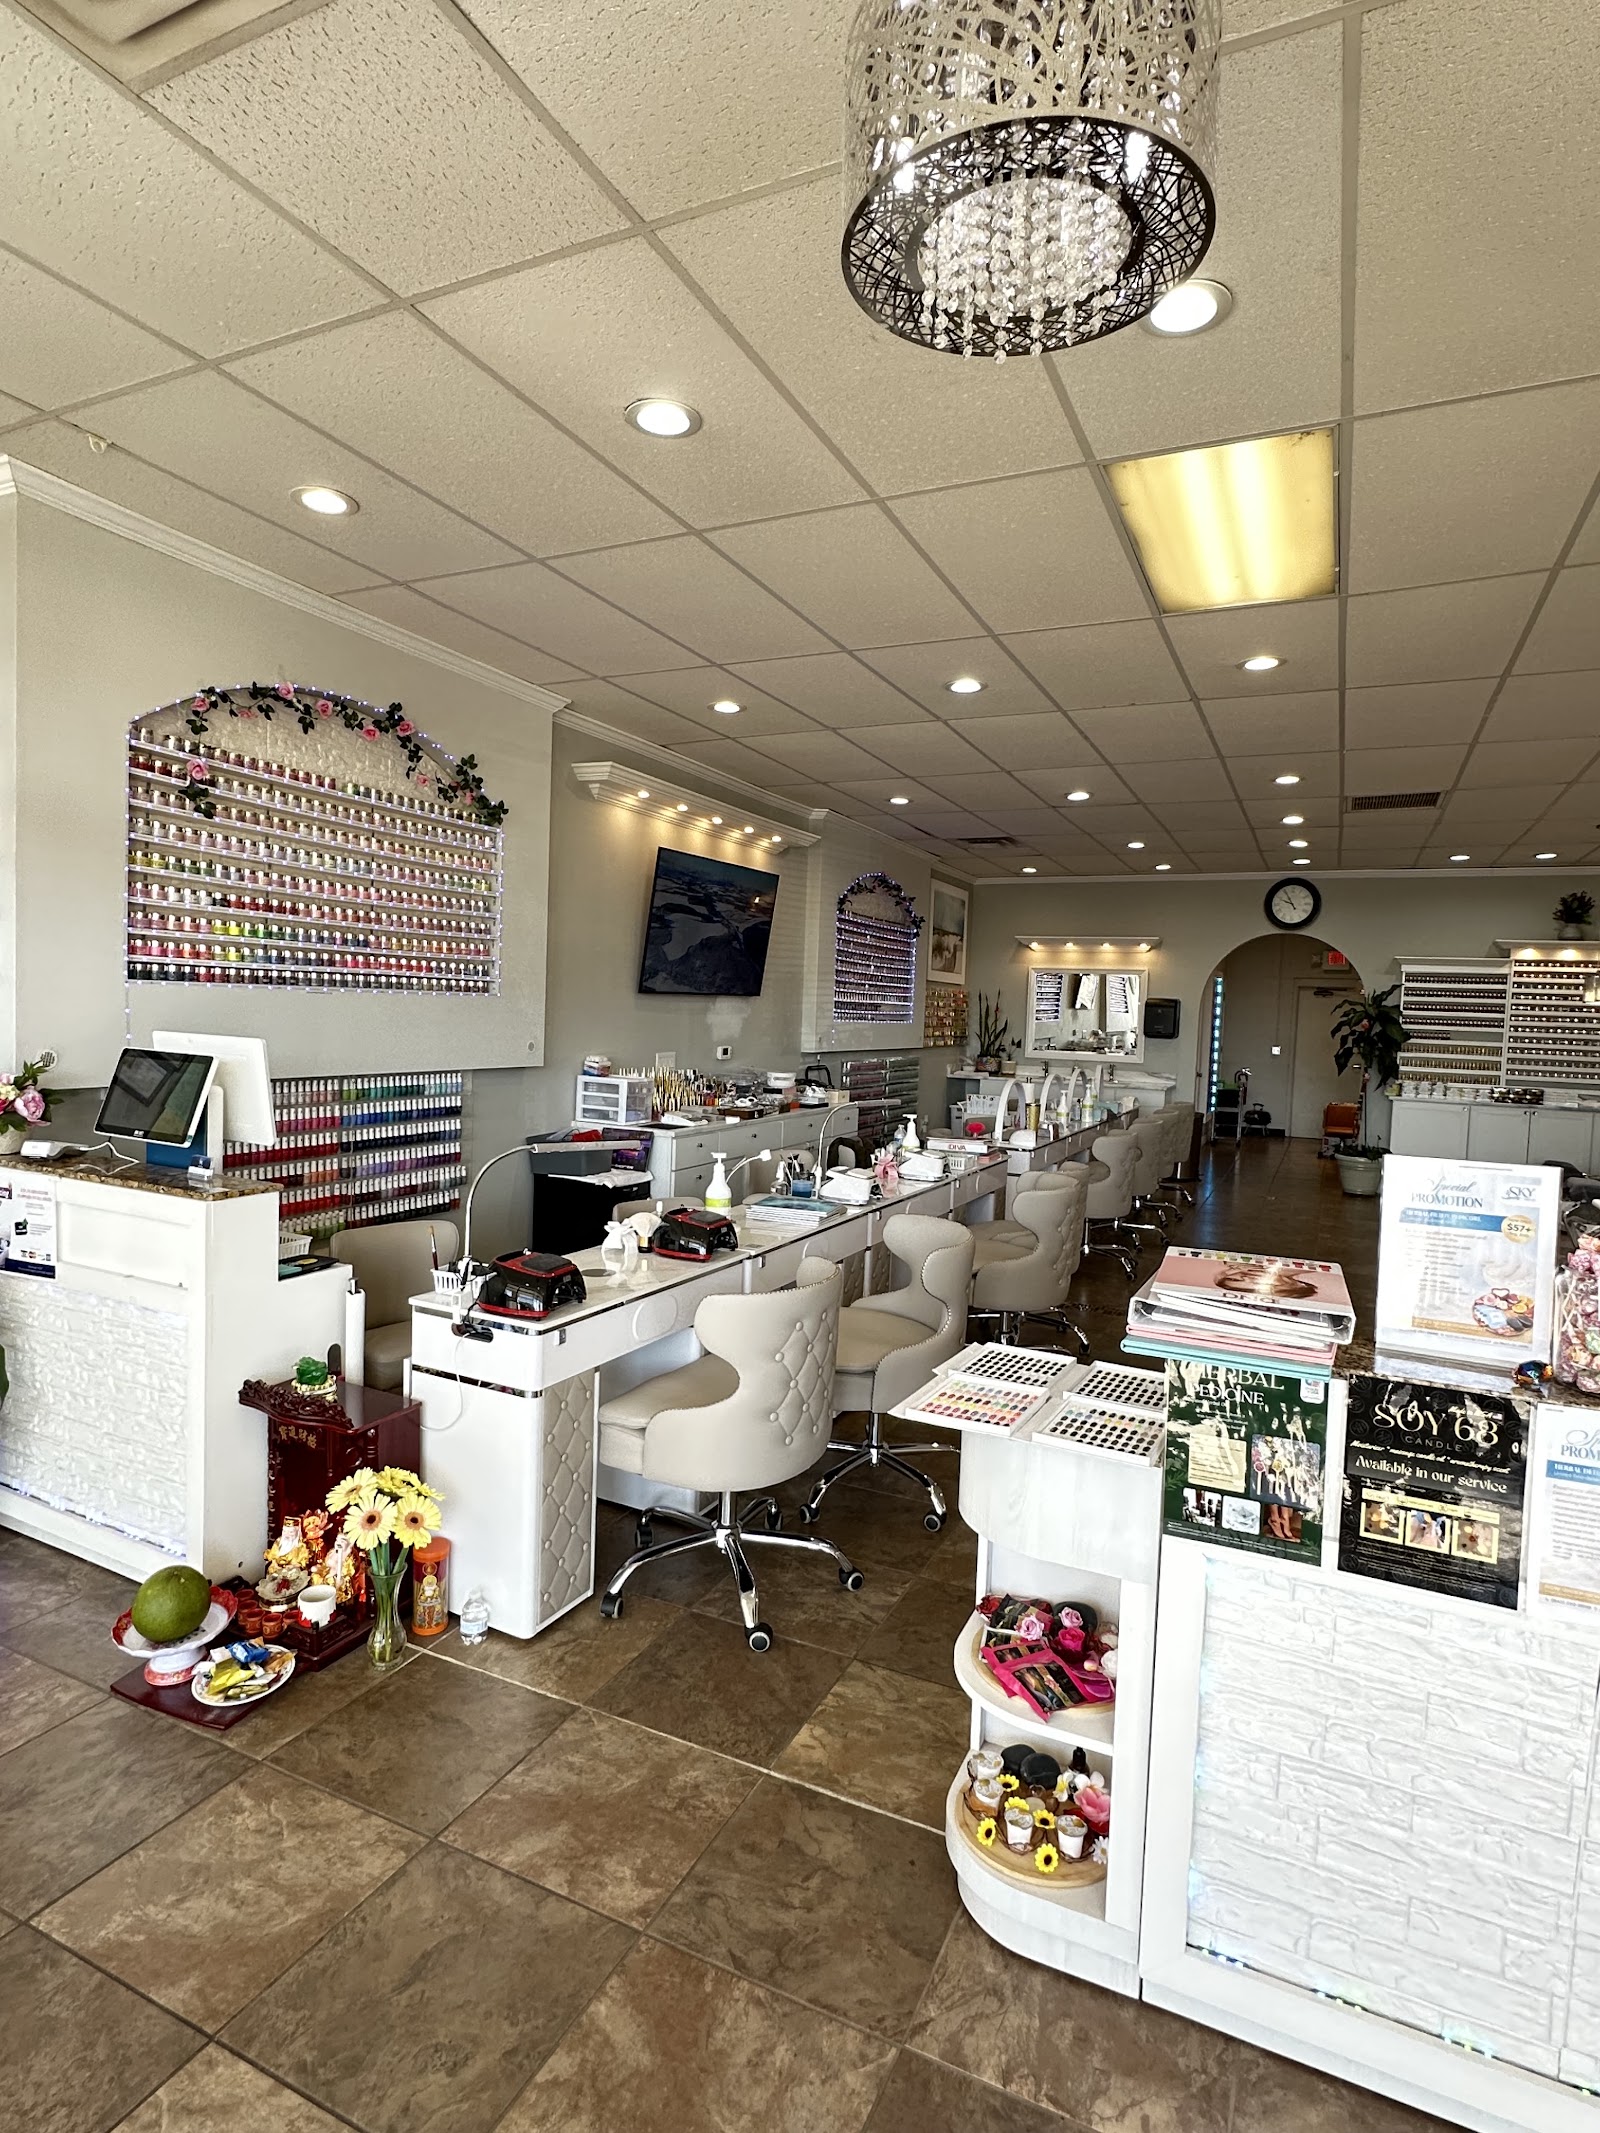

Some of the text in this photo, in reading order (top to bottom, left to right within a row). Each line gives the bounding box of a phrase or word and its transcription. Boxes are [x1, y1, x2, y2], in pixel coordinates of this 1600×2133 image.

[948, 1143, 967, 1151] DIVA
[1411, 1193, 1483, 1208] PROMOTION
[1506, 1222, 1532, 1232] $57+
[1373, 1403, 1447, 1436] SOY
[1454, 1416, 1499, 1446] 68
[1405, 1435, 1463, 1452] CANDLE
[1355, 1455, 1508, 1493] Available in our service
